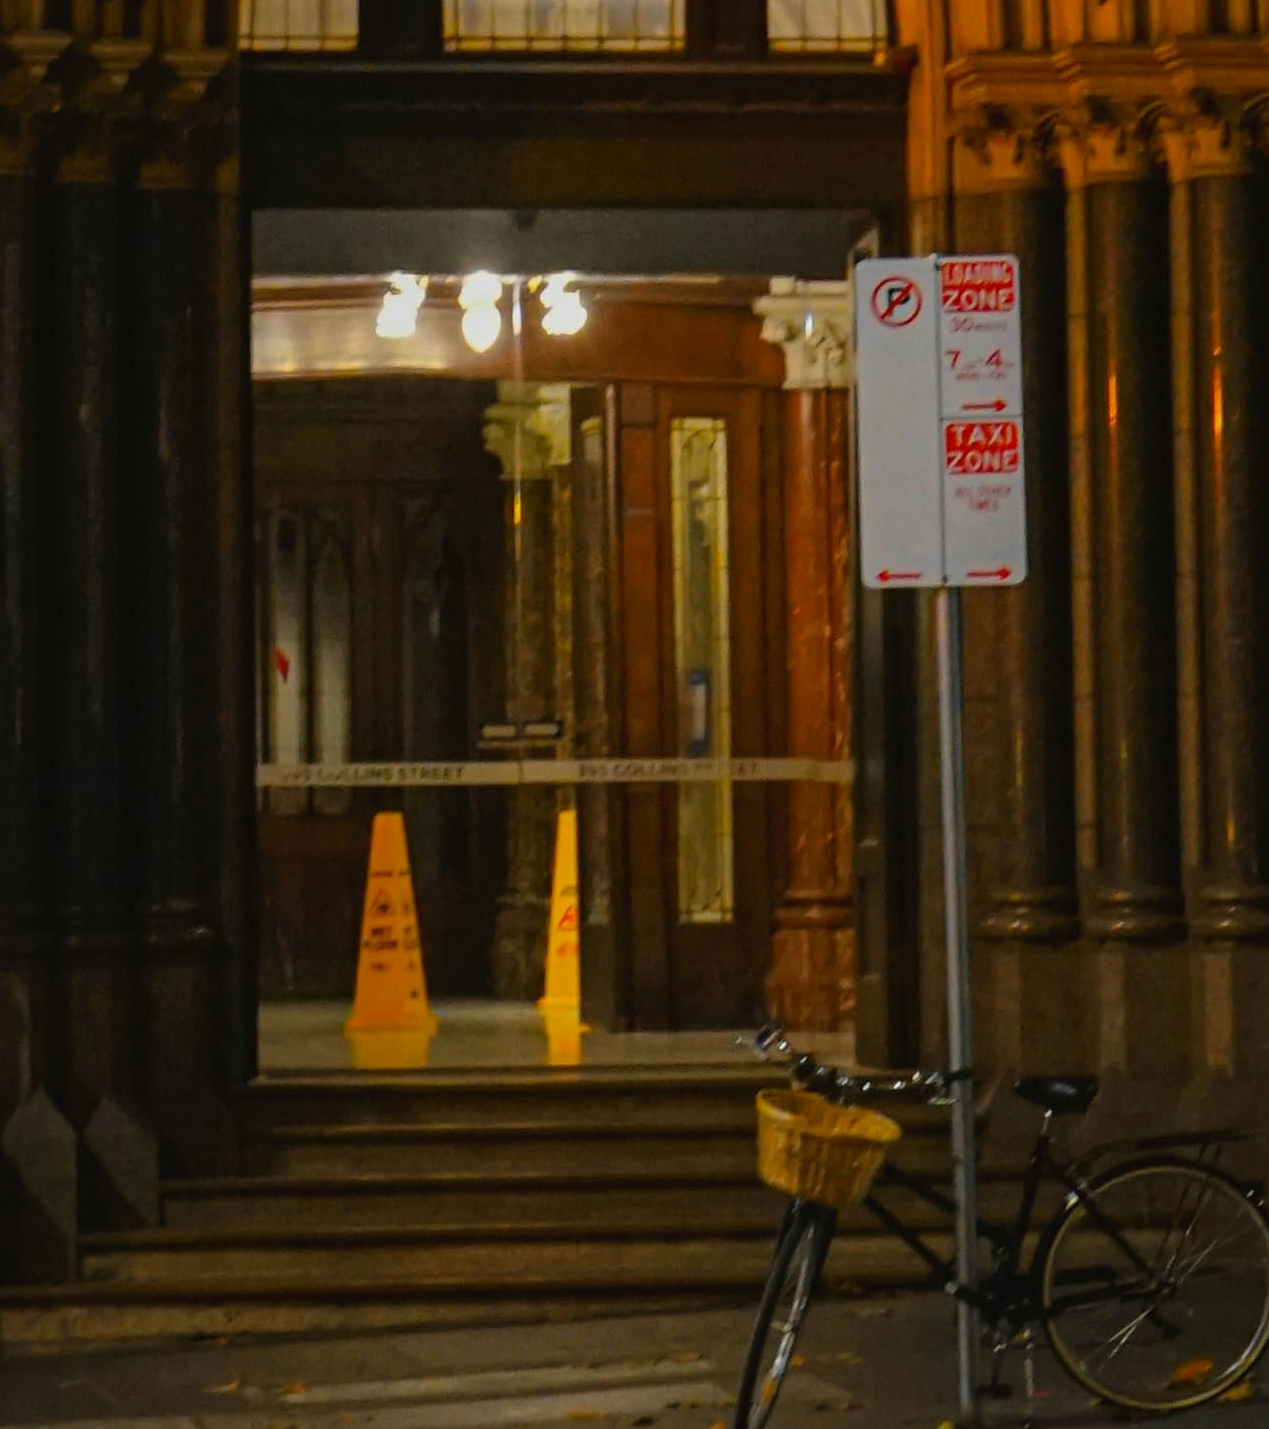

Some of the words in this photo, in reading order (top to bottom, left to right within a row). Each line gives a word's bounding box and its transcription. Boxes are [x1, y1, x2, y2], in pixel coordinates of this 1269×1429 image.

[943, 263, 1014, 286] LOADING
[943, 289, 1014, 312] ZONE
[952, 424, 1016, 447] TAXI
[947, 450, 1019, 472] ZONE
[317, 762, 394, 782] COLLINS
[397, 761, 465, 781] STREET
